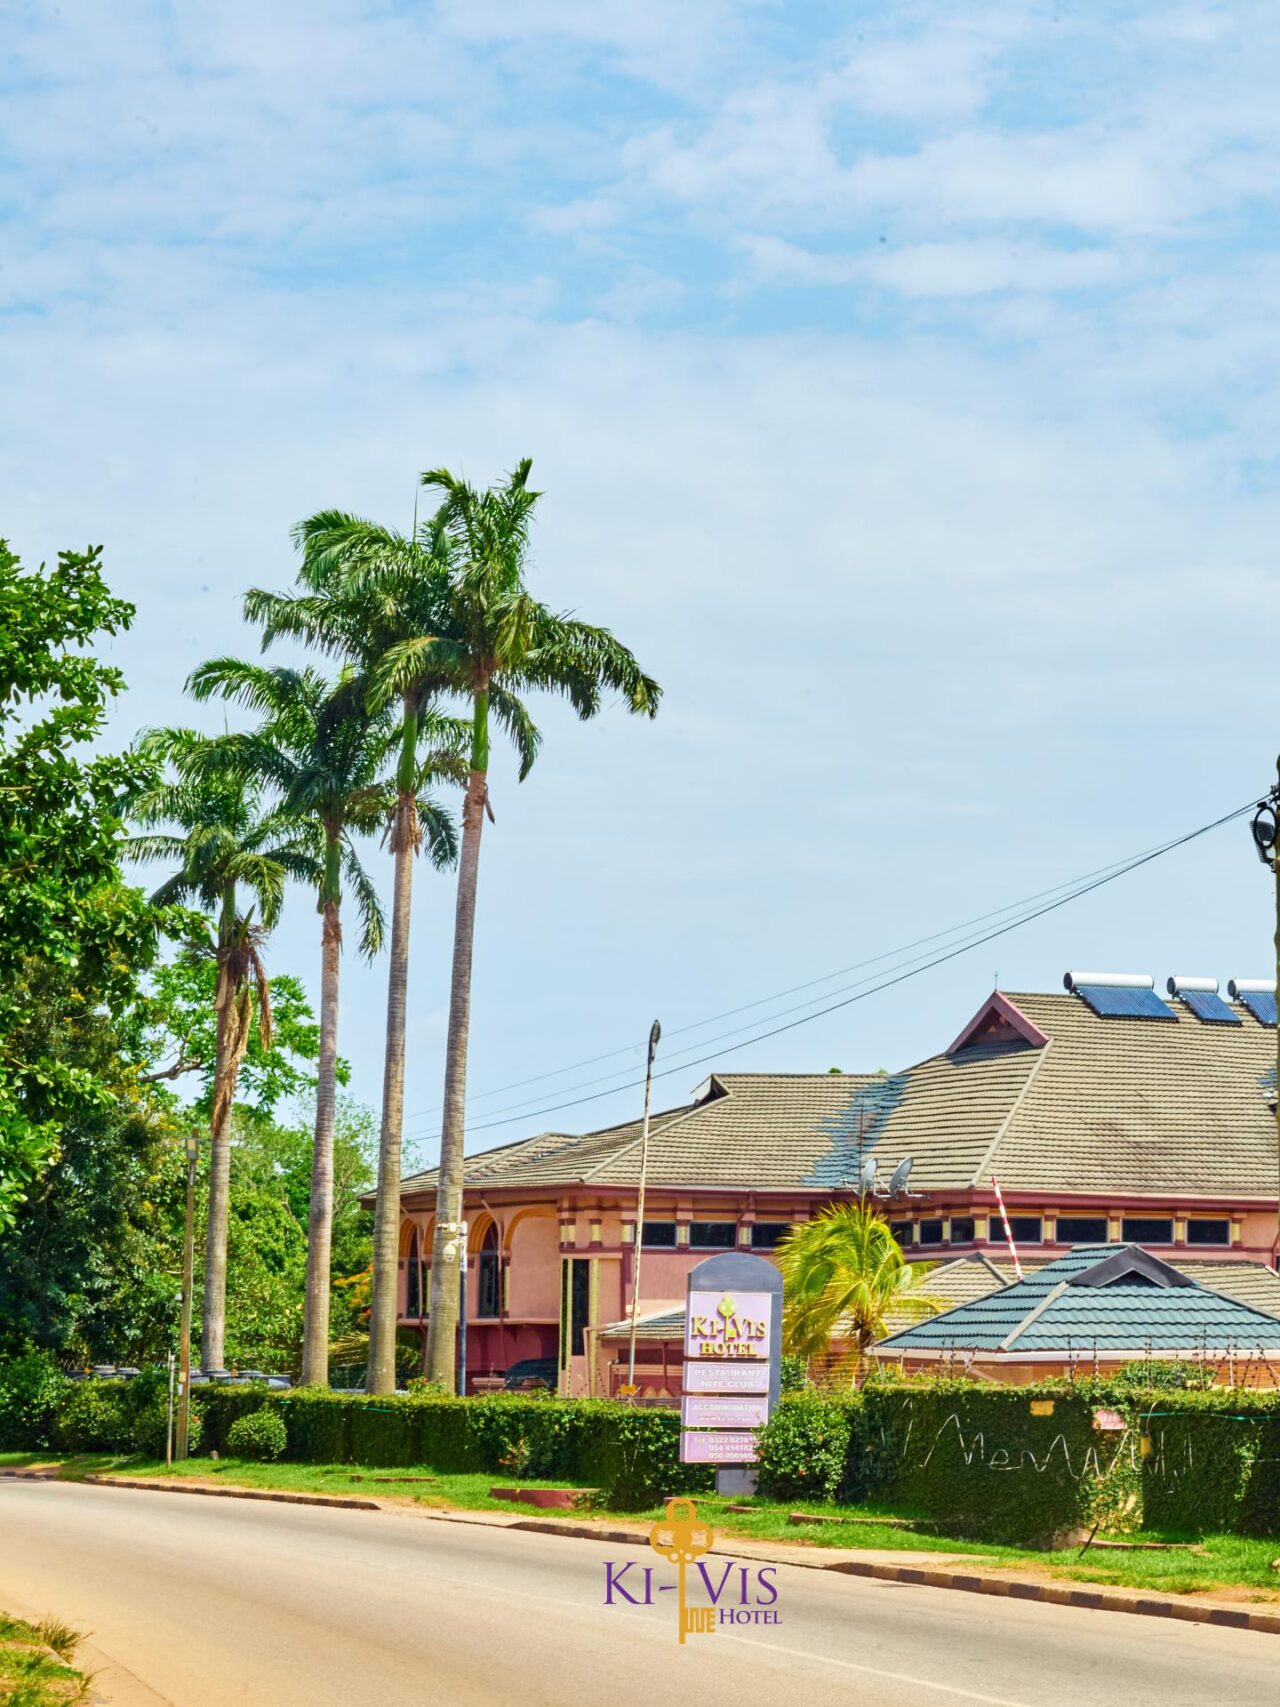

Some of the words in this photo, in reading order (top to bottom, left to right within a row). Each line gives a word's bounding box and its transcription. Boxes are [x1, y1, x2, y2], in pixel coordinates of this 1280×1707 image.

[700, 1342, 758, 1356] HOTEL
[695, 1368, 761, 1377] RESTAURANT
[702, 1380, 726, 1388] NITE
[728, 1380, 754, 1388] CLUB
[692, 1403, 763, 1412] ACCOMMODATION
